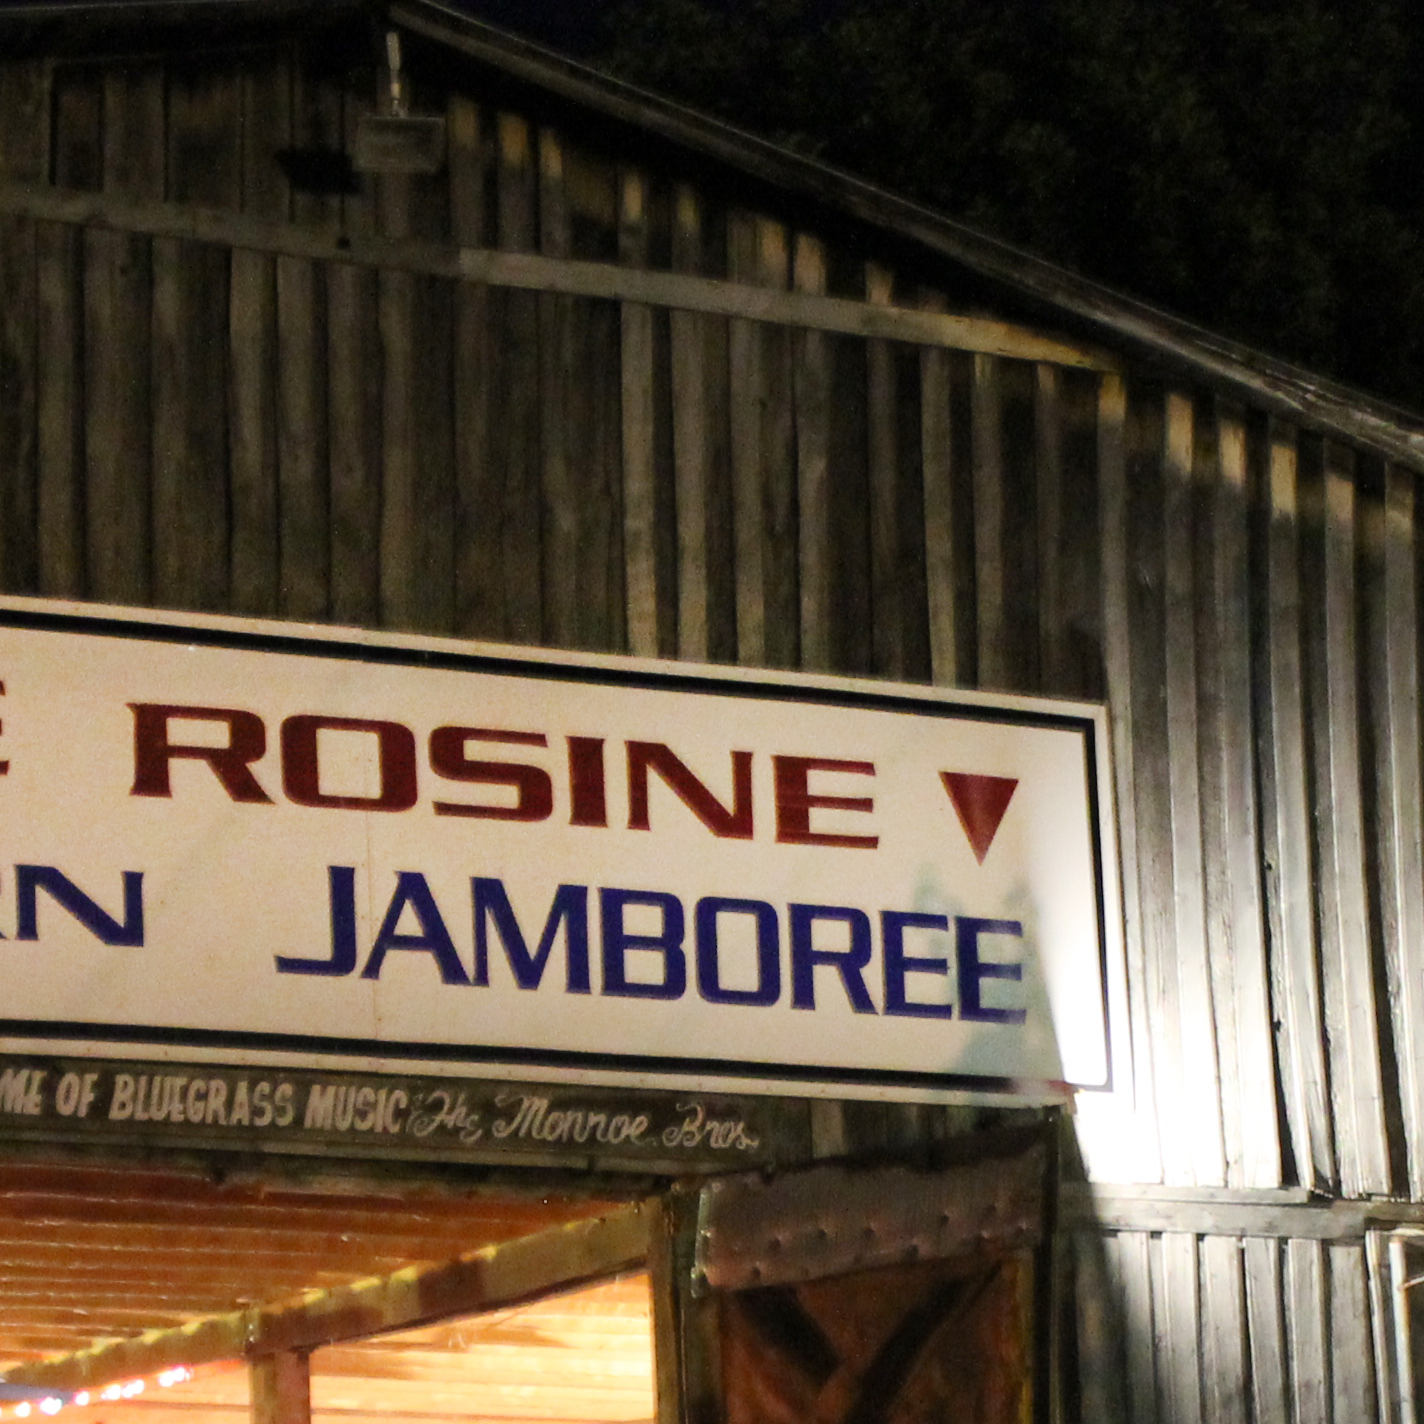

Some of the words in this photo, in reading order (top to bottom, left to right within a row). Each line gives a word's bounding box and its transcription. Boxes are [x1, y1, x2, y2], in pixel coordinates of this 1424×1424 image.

[127, 703, 880, 848] ROSINE
[275, 865, 1026, 1024] JAMBOREE
[55, 1072, 98, 1118] OF
[108, 1073, 295, 1127] BLUEGRASS
[303, 1083, 408, 1134] MUSIC
[414, 1090, 483, 1144] The
[493, 1094, 657, 1145] Monroe
